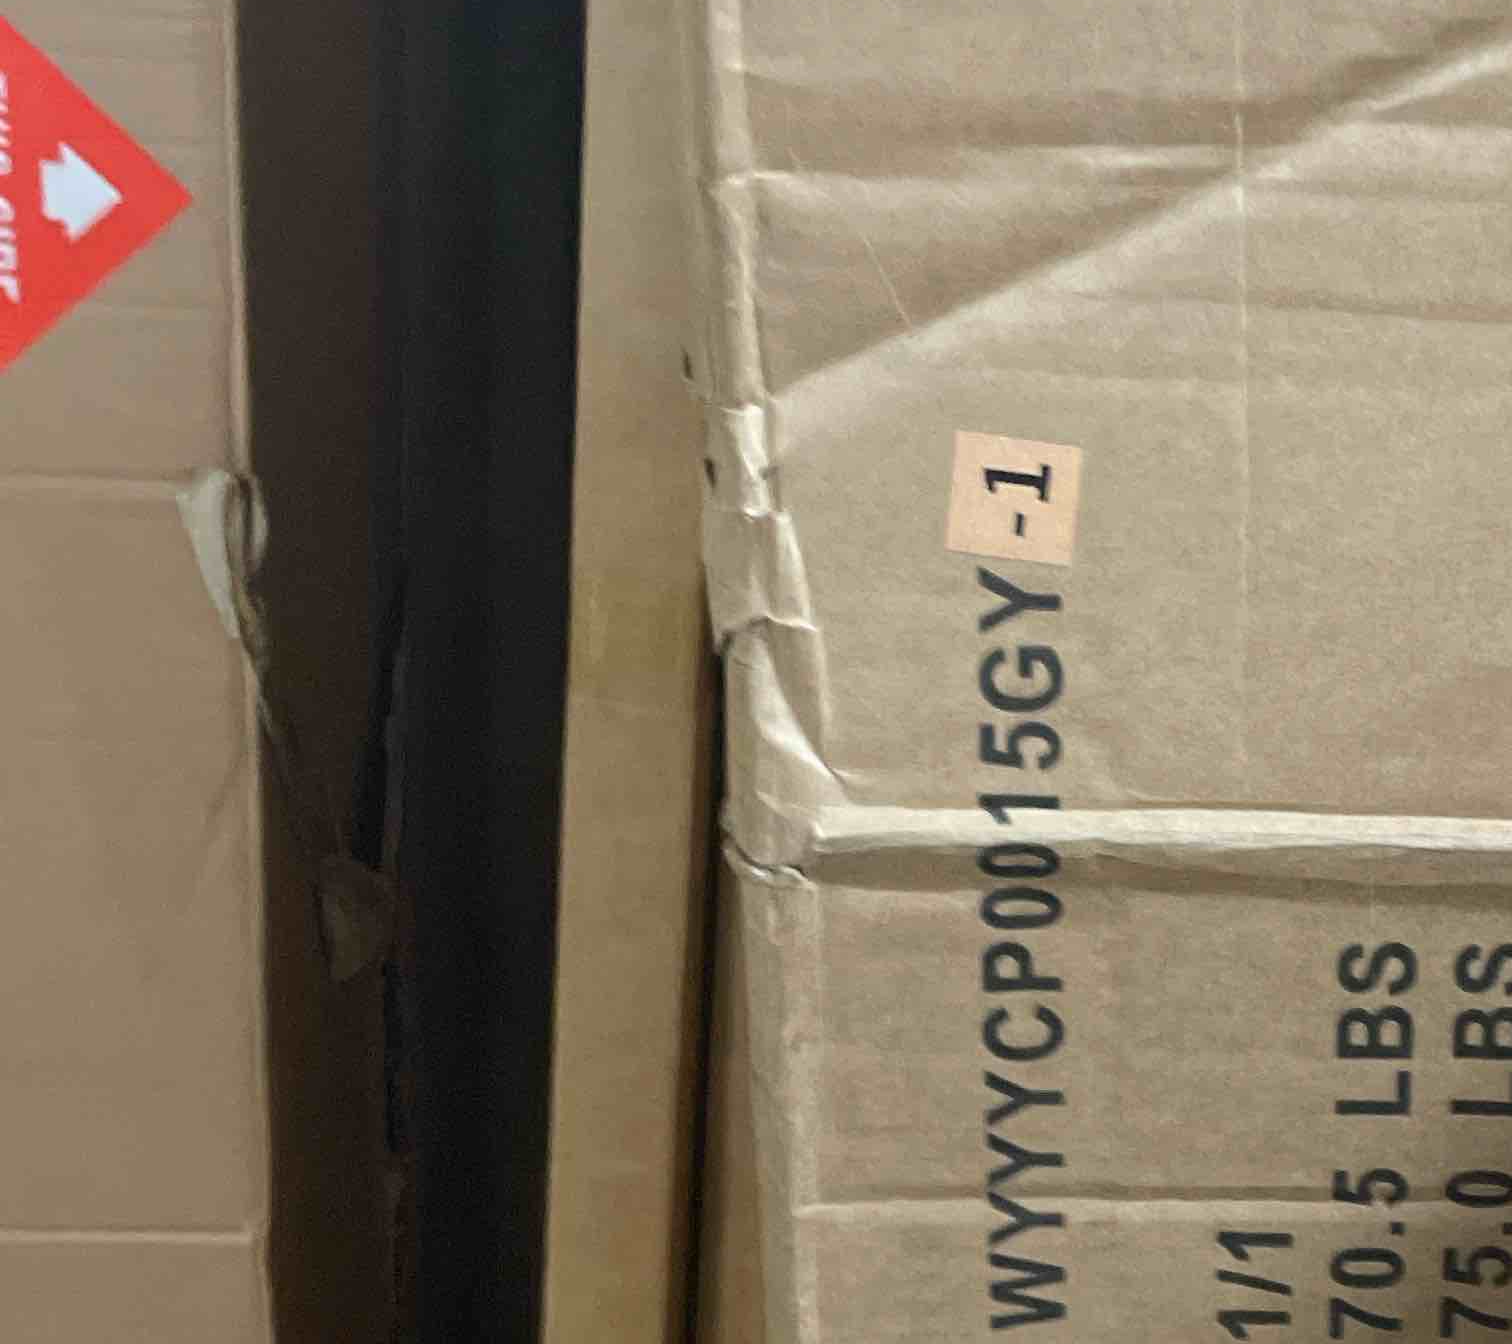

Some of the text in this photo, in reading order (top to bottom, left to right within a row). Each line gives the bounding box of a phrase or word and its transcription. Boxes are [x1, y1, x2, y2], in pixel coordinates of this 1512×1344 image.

[978, 567, 1067, 1330] WYYYCP0015GY
[1335, 942, 1417, 1116] LBS
[1216, 1231, 1294, 1341] 1/1
[1329, 1168, 1410, 1340] 70.5
